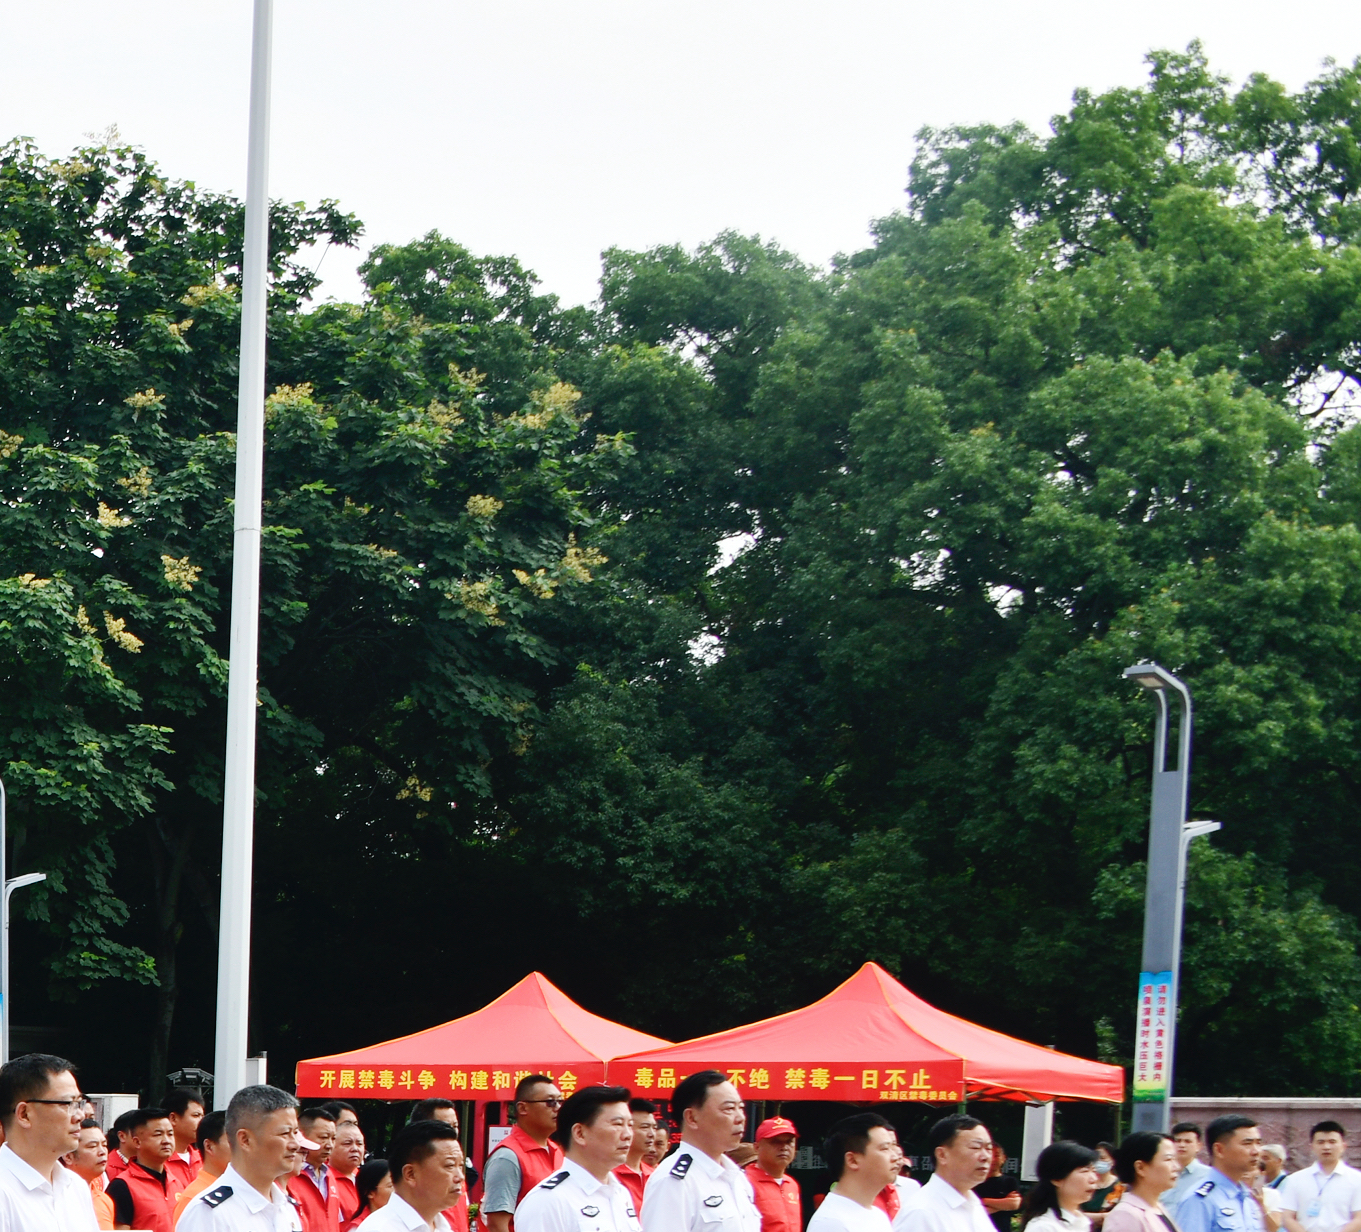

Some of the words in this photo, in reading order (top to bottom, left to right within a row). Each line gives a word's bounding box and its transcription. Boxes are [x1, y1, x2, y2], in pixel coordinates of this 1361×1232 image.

[319, 1069, 437, 1090] 开展禁毒斗争
[449, 1070, 578, 1091] 构建和会
[634, 1067, 770, 1090] 毒品不绝
[785, 1068, 932, 1091] 禁毒一日不止
[879, 1090, 958, 1101] 双清区禁毒委员会
